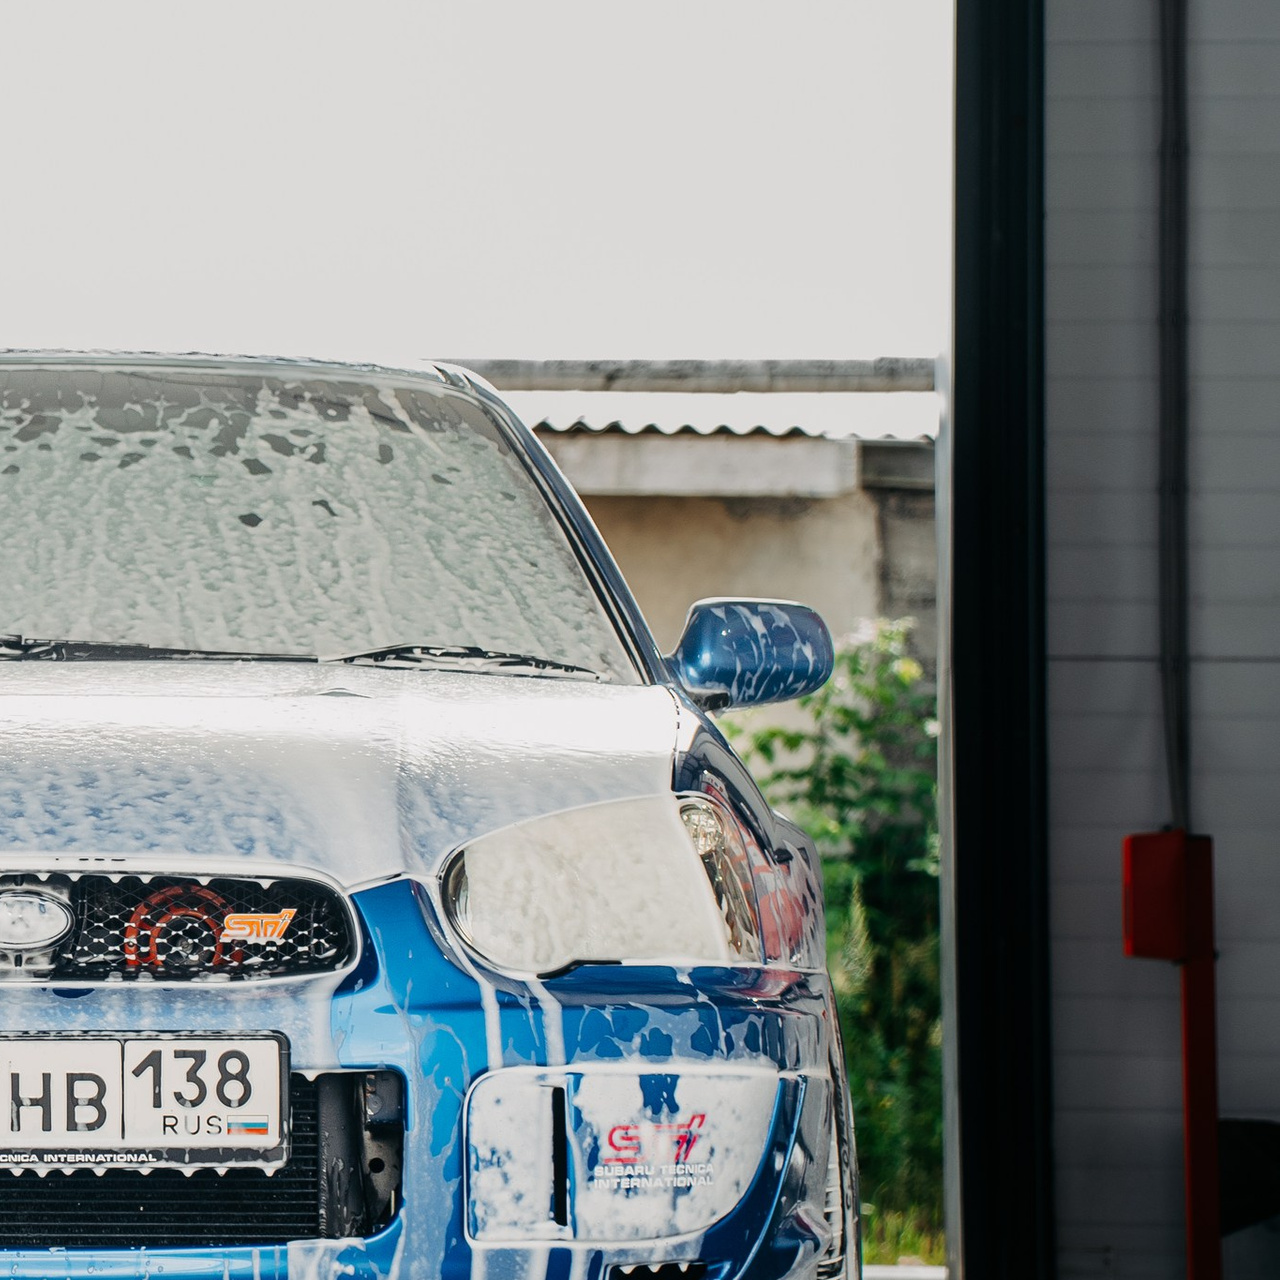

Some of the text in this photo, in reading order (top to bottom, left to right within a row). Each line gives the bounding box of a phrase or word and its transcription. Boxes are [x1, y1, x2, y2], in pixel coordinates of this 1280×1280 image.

[131, 1049, 252, 1109] 138
[162, 1115, 222, 1136] RUS
[43, 1152, 157, 1163] INTERNATIONAL
[593, 1163, 714, 1177] SUBARU TECNICA
[593, 1176, 714, 1189] INTERNATIONAL
